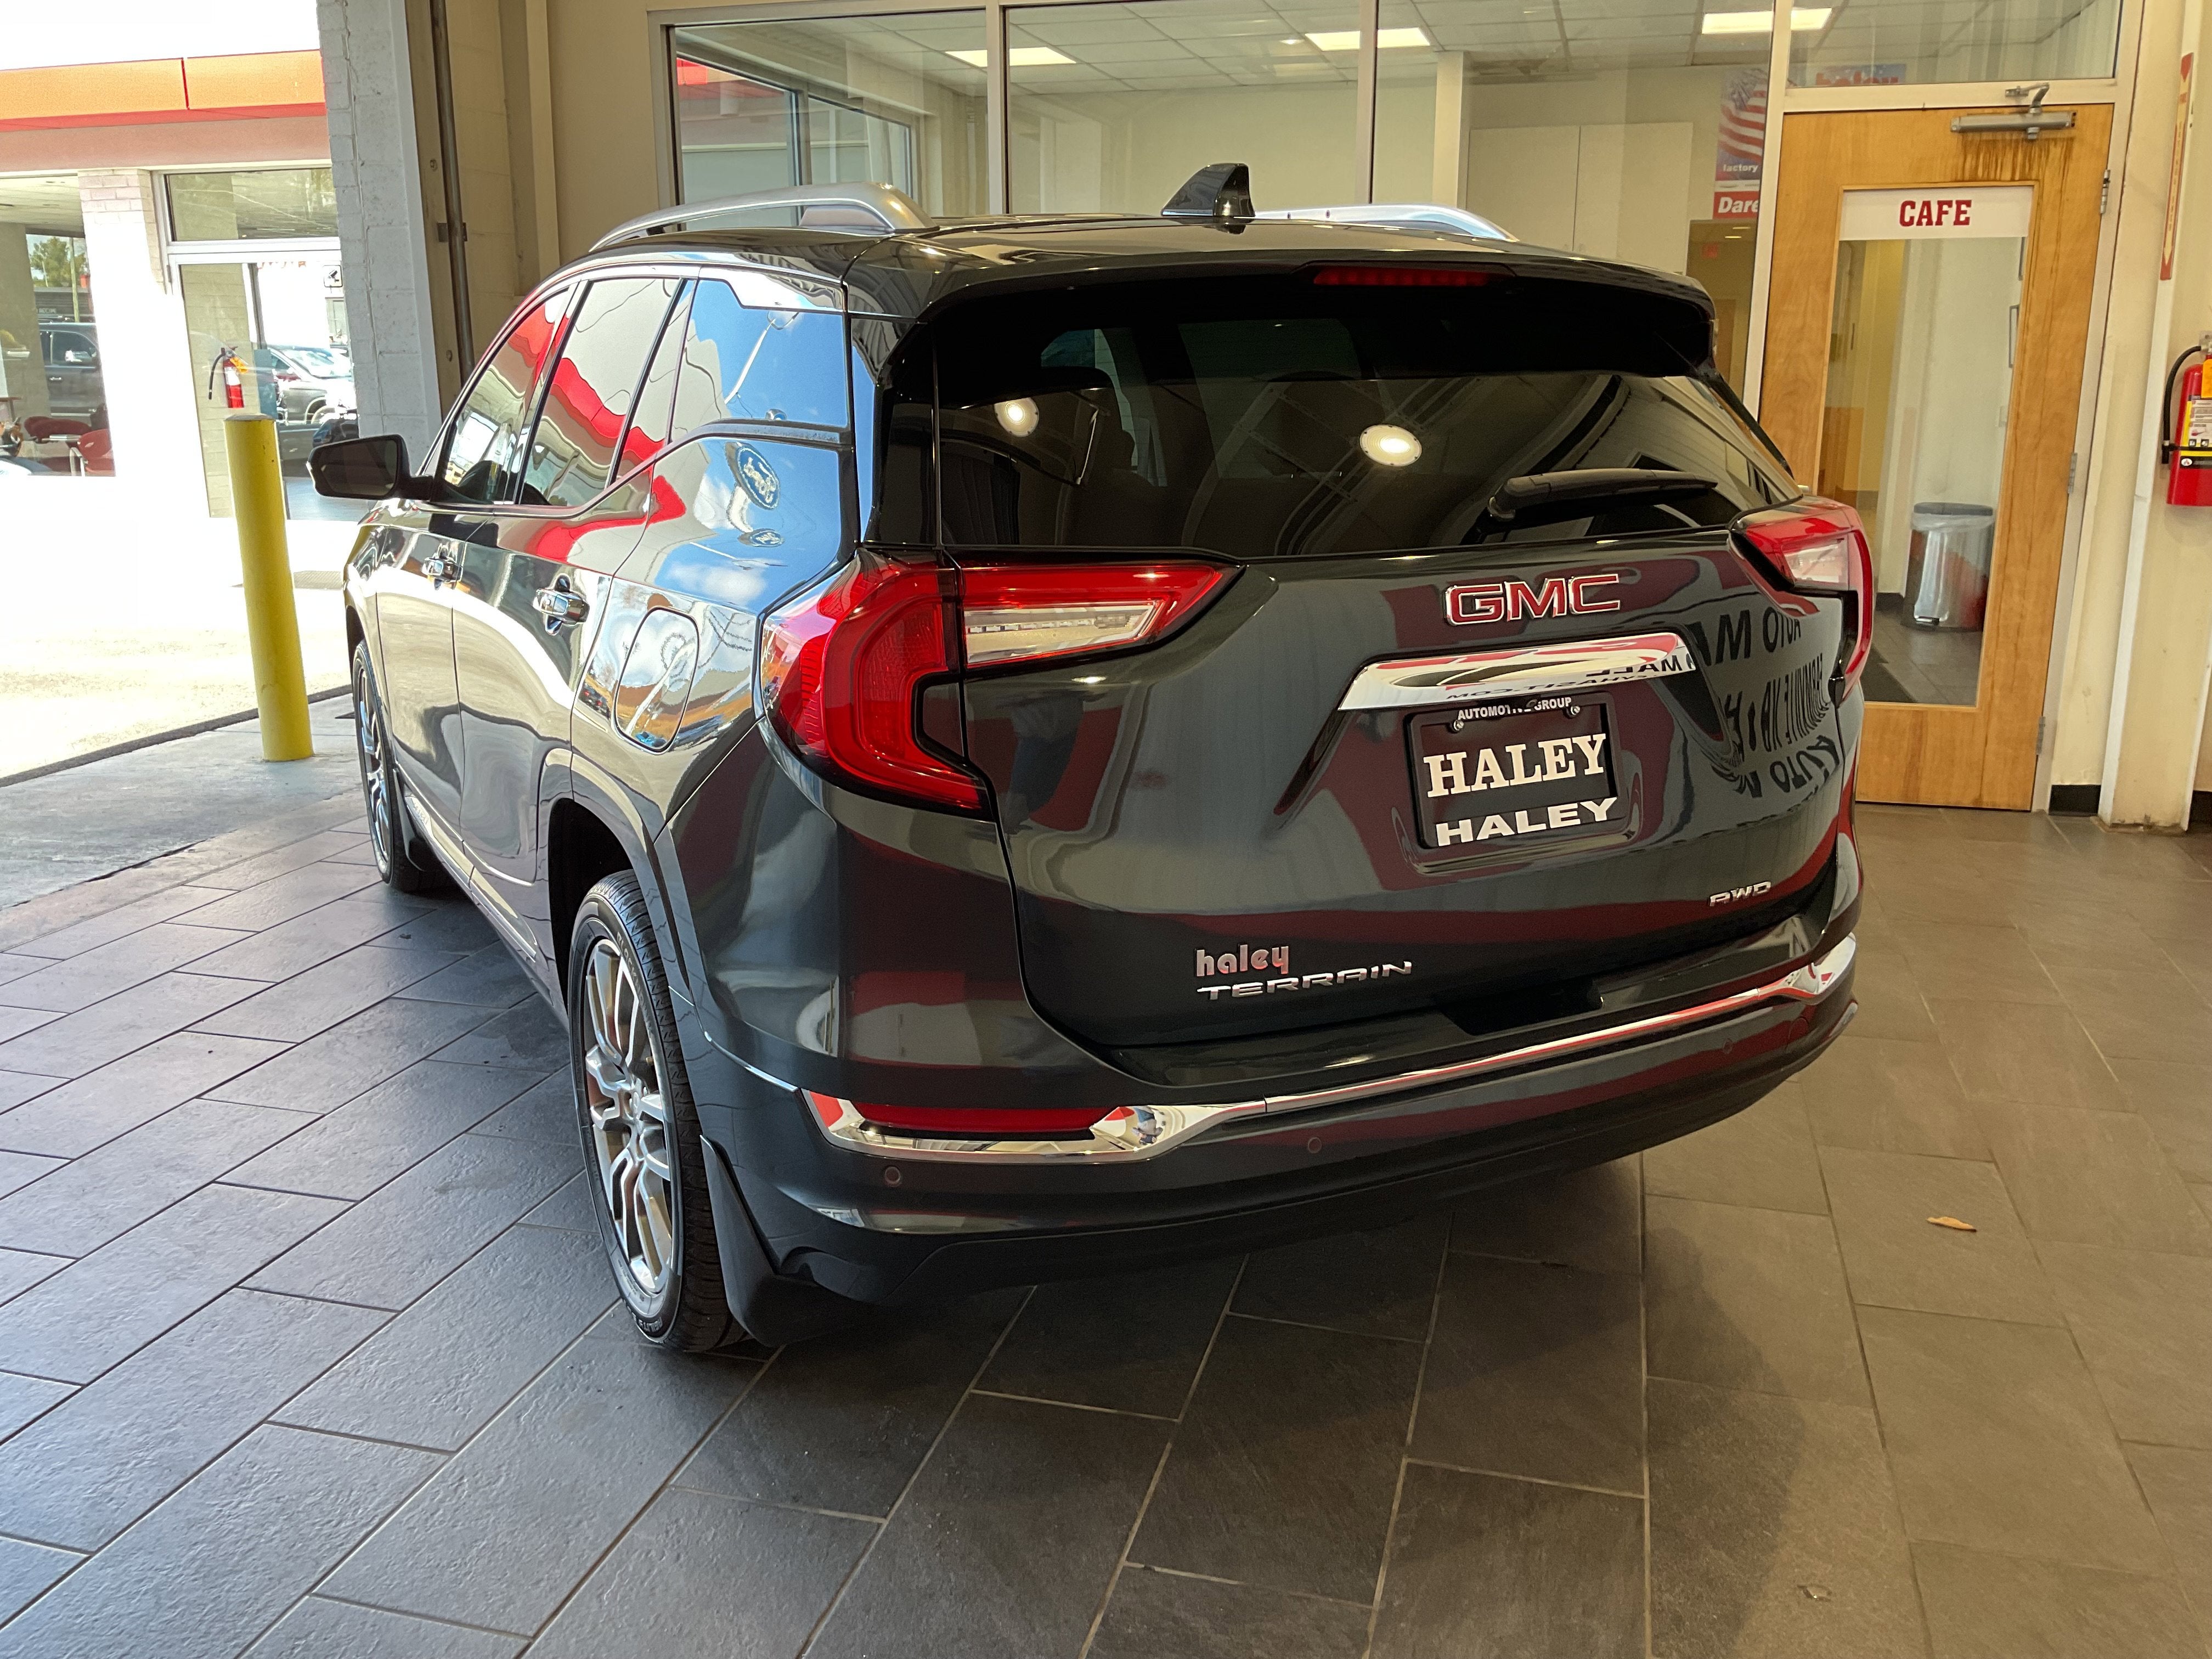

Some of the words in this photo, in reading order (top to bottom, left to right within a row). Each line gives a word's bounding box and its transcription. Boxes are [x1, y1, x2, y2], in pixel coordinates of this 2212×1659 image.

[1718, 196, 1759, 213] Dare
[1899, 199, 1972, 227] CAFE
[1445, 573, 1621, 625] GMC
[1534, 697, 1572, 711] GROUP
[1423, 733, 1606, 798] HALEY
[1436, 797, 1618, 847] HALEY
[1709, 881, 1771, 907] AWD
[1196, 944, 1289, 977] haley
[1197, 961, 1412, 1000] TERRAIN
